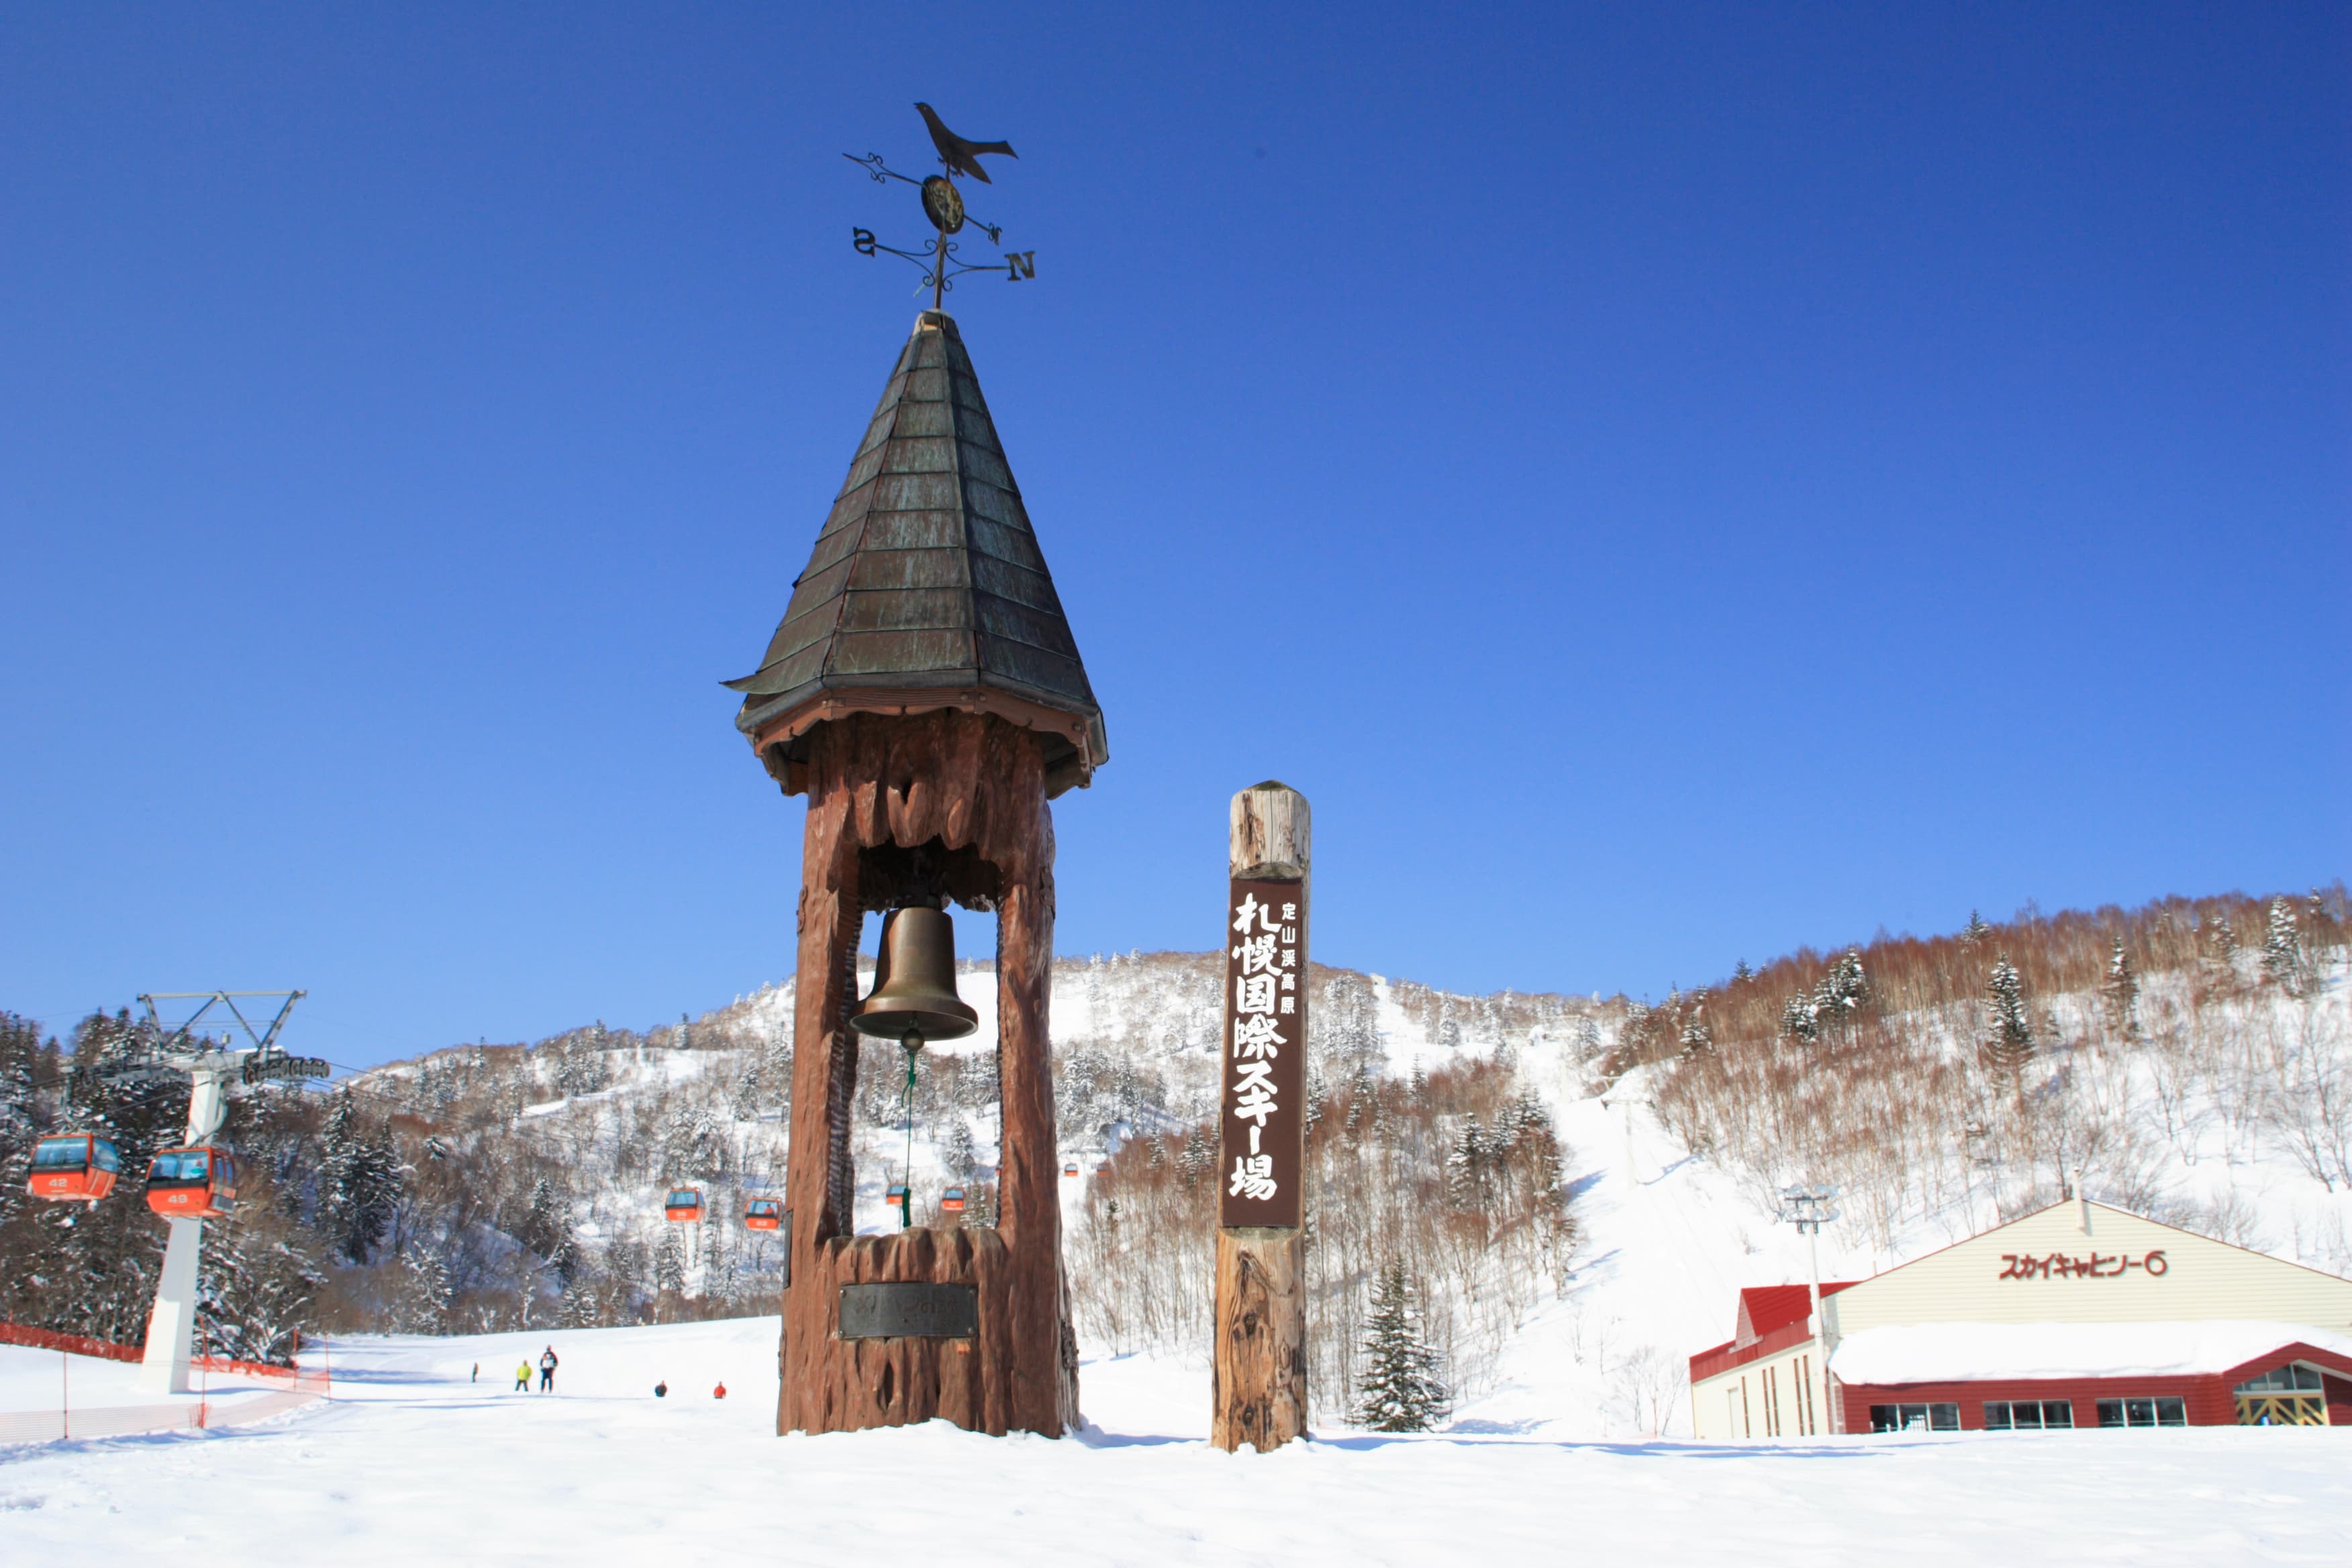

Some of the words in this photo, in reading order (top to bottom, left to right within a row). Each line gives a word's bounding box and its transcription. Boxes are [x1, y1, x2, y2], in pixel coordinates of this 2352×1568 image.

[1004, 250, 1036, 282] N
[1280, 902, 1296, 1014] 定山渓高原
[1228, 892, 1288, 1201] 札幌国際スキー場
[48, 1178, 68, 1187] 42
[168, 1194, 188, 1204] 49
